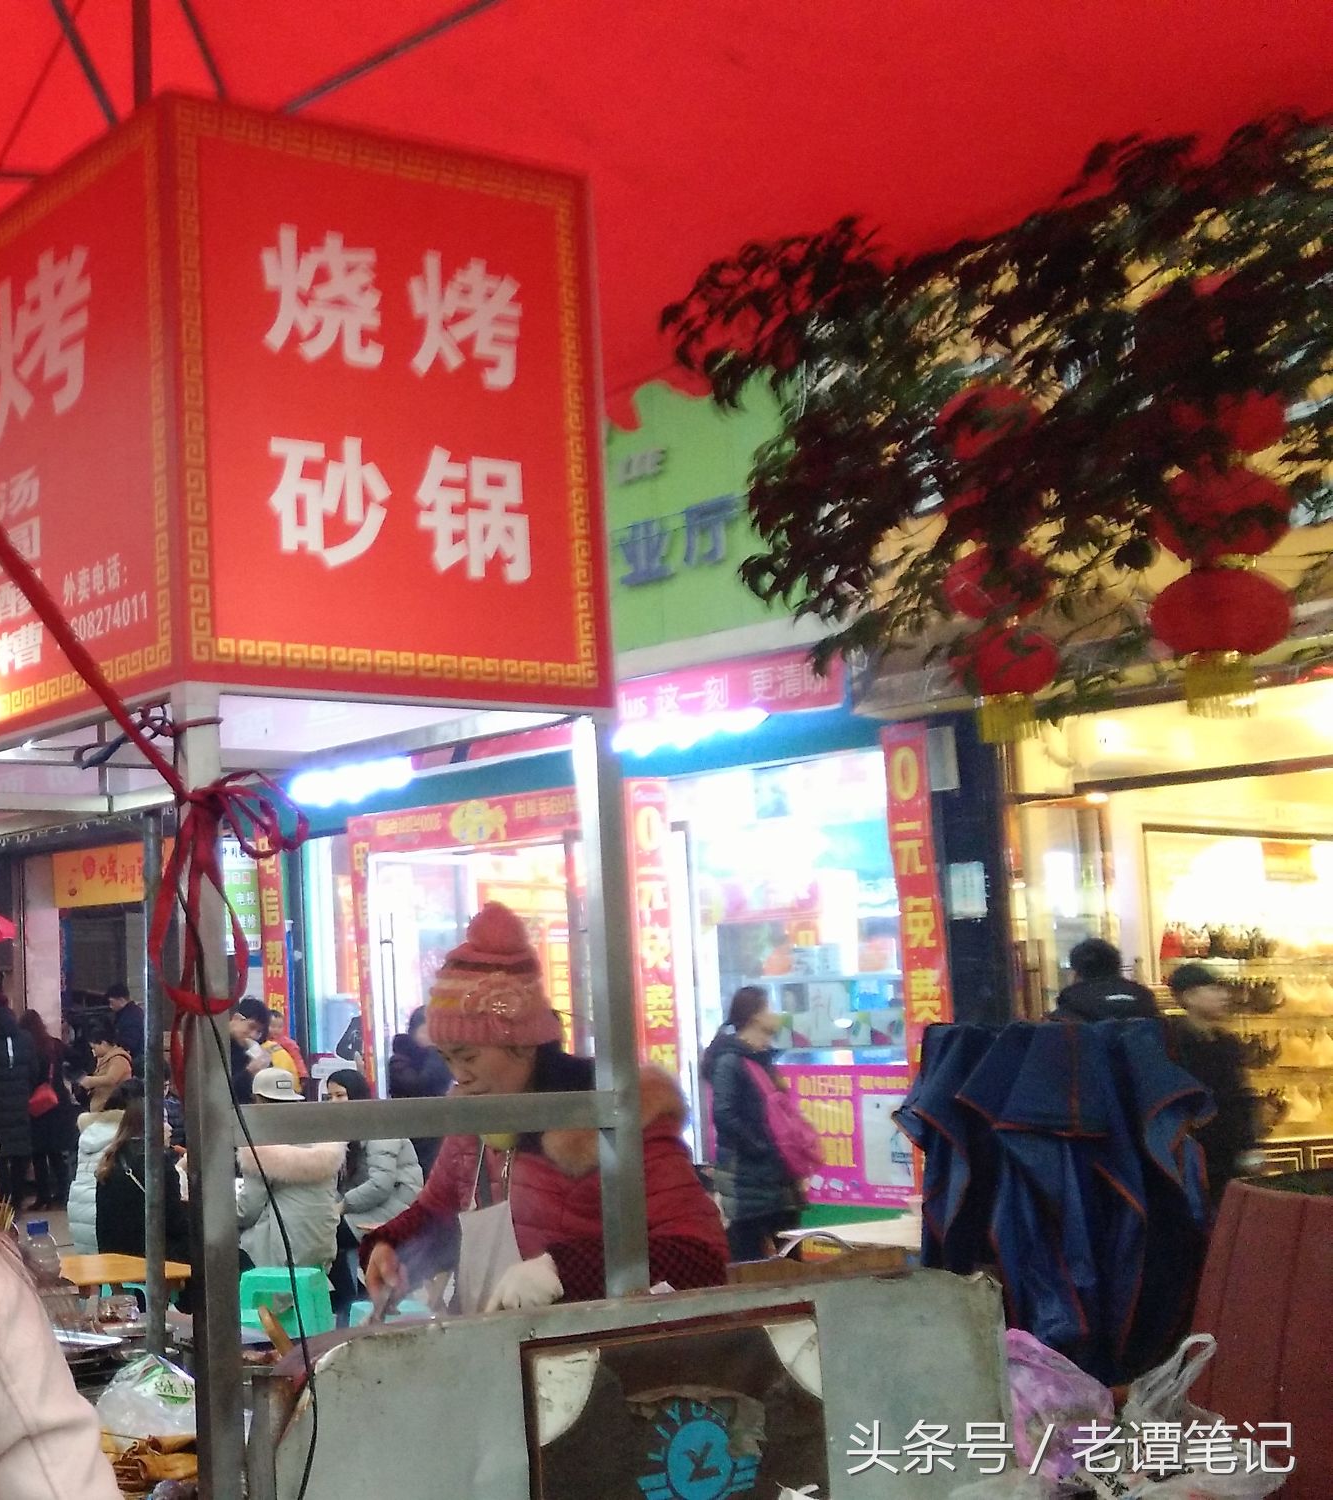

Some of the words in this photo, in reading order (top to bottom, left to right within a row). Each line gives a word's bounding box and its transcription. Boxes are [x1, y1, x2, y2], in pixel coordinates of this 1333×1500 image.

[261, 222, 523, 392] 烧烤
[269, 435, 533, 585] 砂锅
[890, 746, 943, 1063] 0元免费
